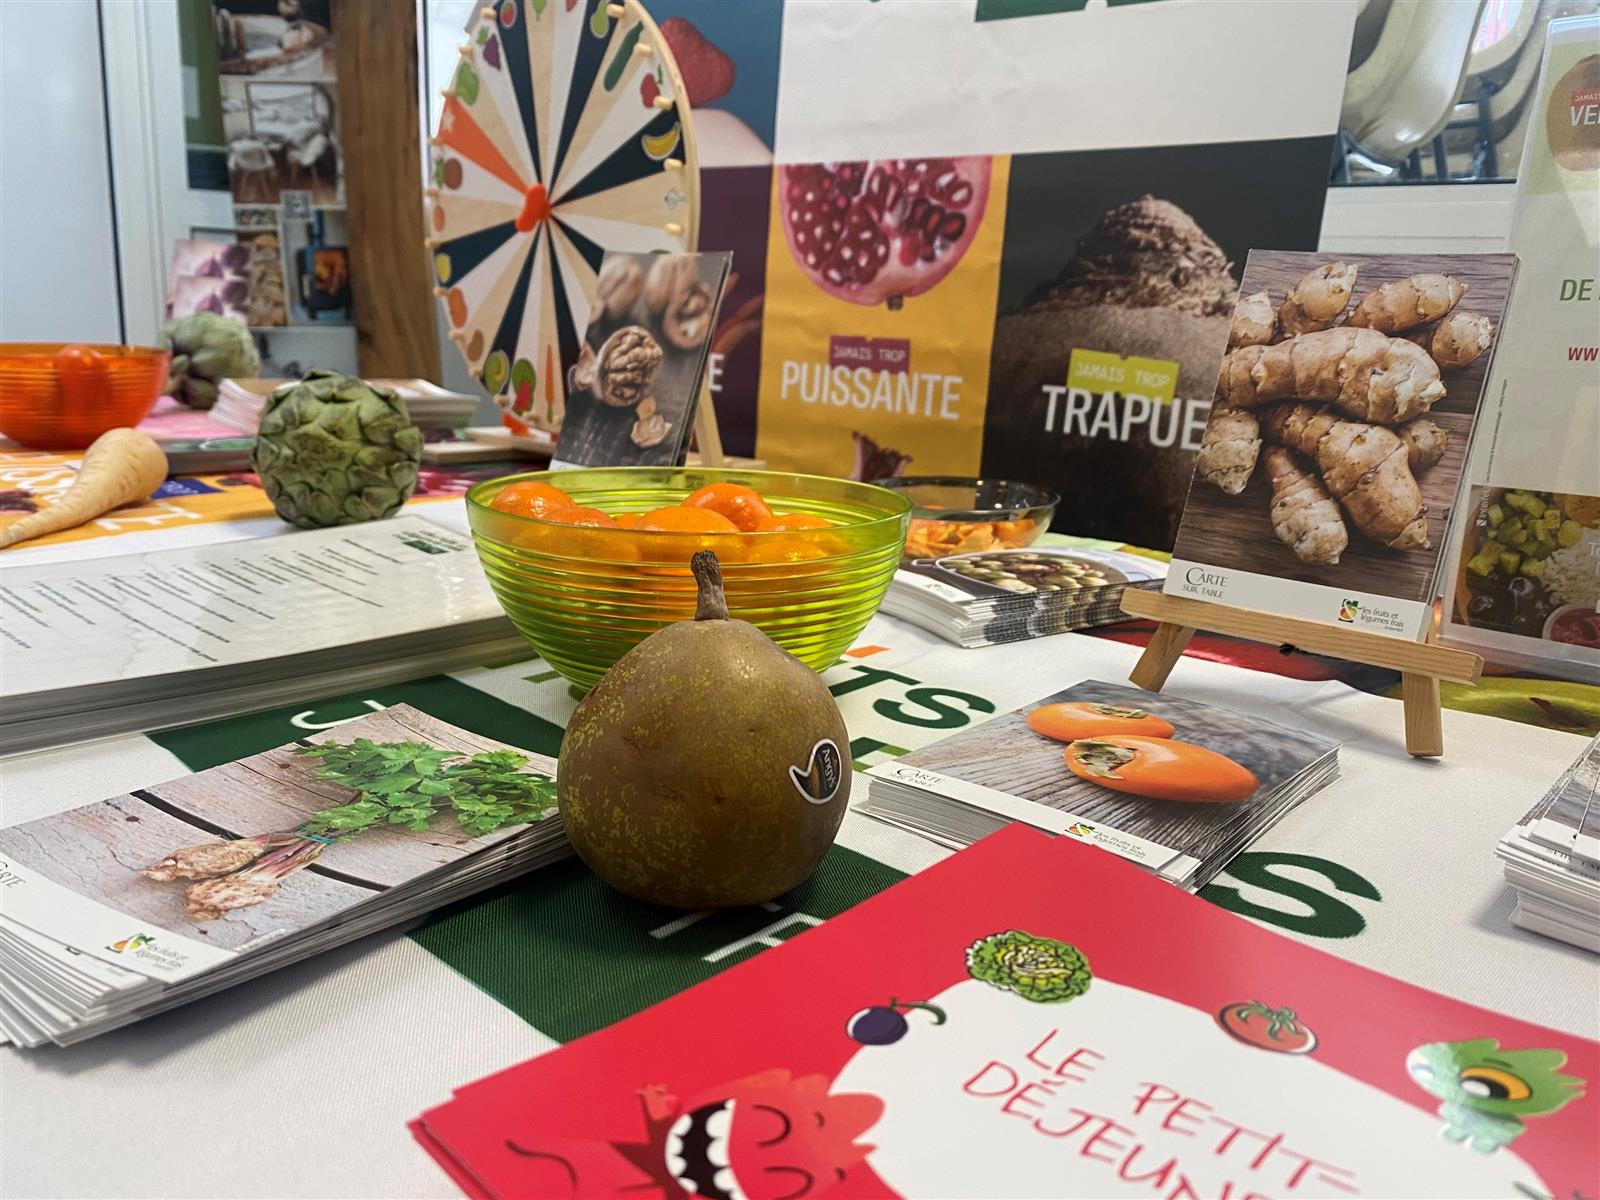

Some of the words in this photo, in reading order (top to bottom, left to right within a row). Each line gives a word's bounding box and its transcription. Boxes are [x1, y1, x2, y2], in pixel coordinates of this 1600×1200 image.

[1570, 104, 1600, 127] VE
[1560, 279, 1594, 301] DE
[832, 345, 872, 361] JAMAIS
[879, 348, 907, 363] TROP
[1075, 362, 1126, 383] JAMAIS
[1135, 370, 1170, 389] TROP
[781, 360, 963, 420] PUISSANTE
[1042, 384, 1212, 451] TRAPUE
[1183, 584, 1199, 594] SUR
[1201, 587, 1225, 599] TABLE
[1373, 607, 1390, 618] fruits
[1390, 619, 1405, 628] frais
[1026, 1029, 1106, 1082] LE
[1133, 1082, 1361, 1194] PETIT-
